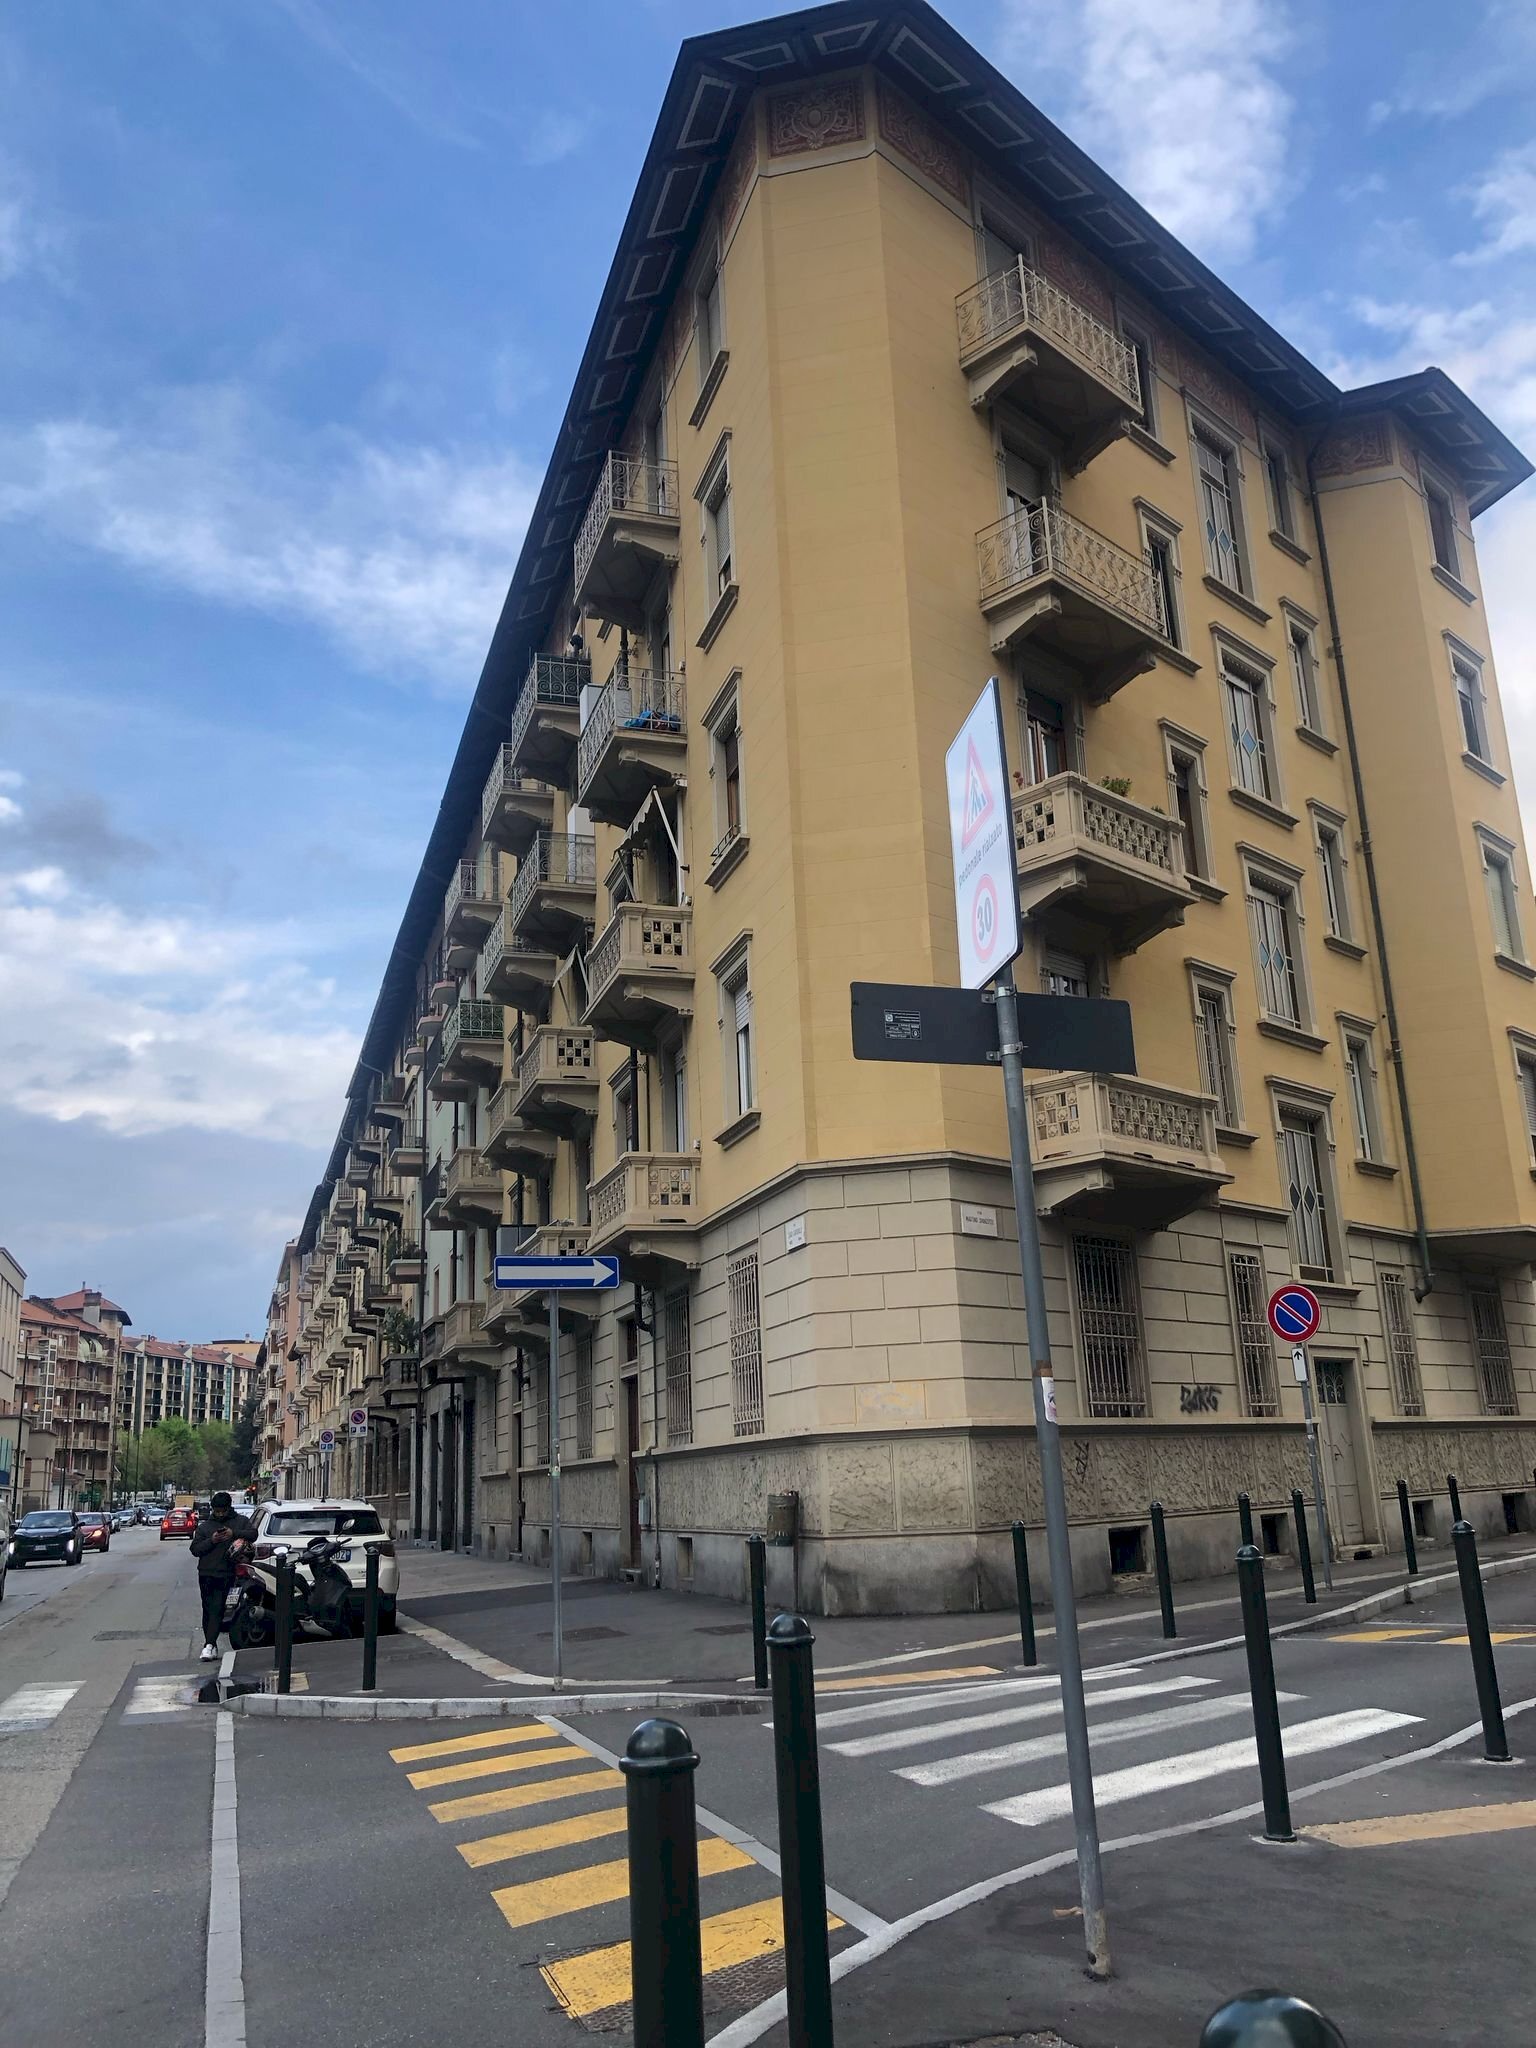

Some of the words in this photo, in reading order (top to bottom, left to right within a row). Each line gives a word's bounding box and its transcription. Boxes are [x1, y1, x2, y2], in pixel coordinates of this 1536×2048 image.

[959, 849, 981, 889] pedonale
[982, 823, 1003, 857] rialzato
[978, 897, 992, 941] 30
